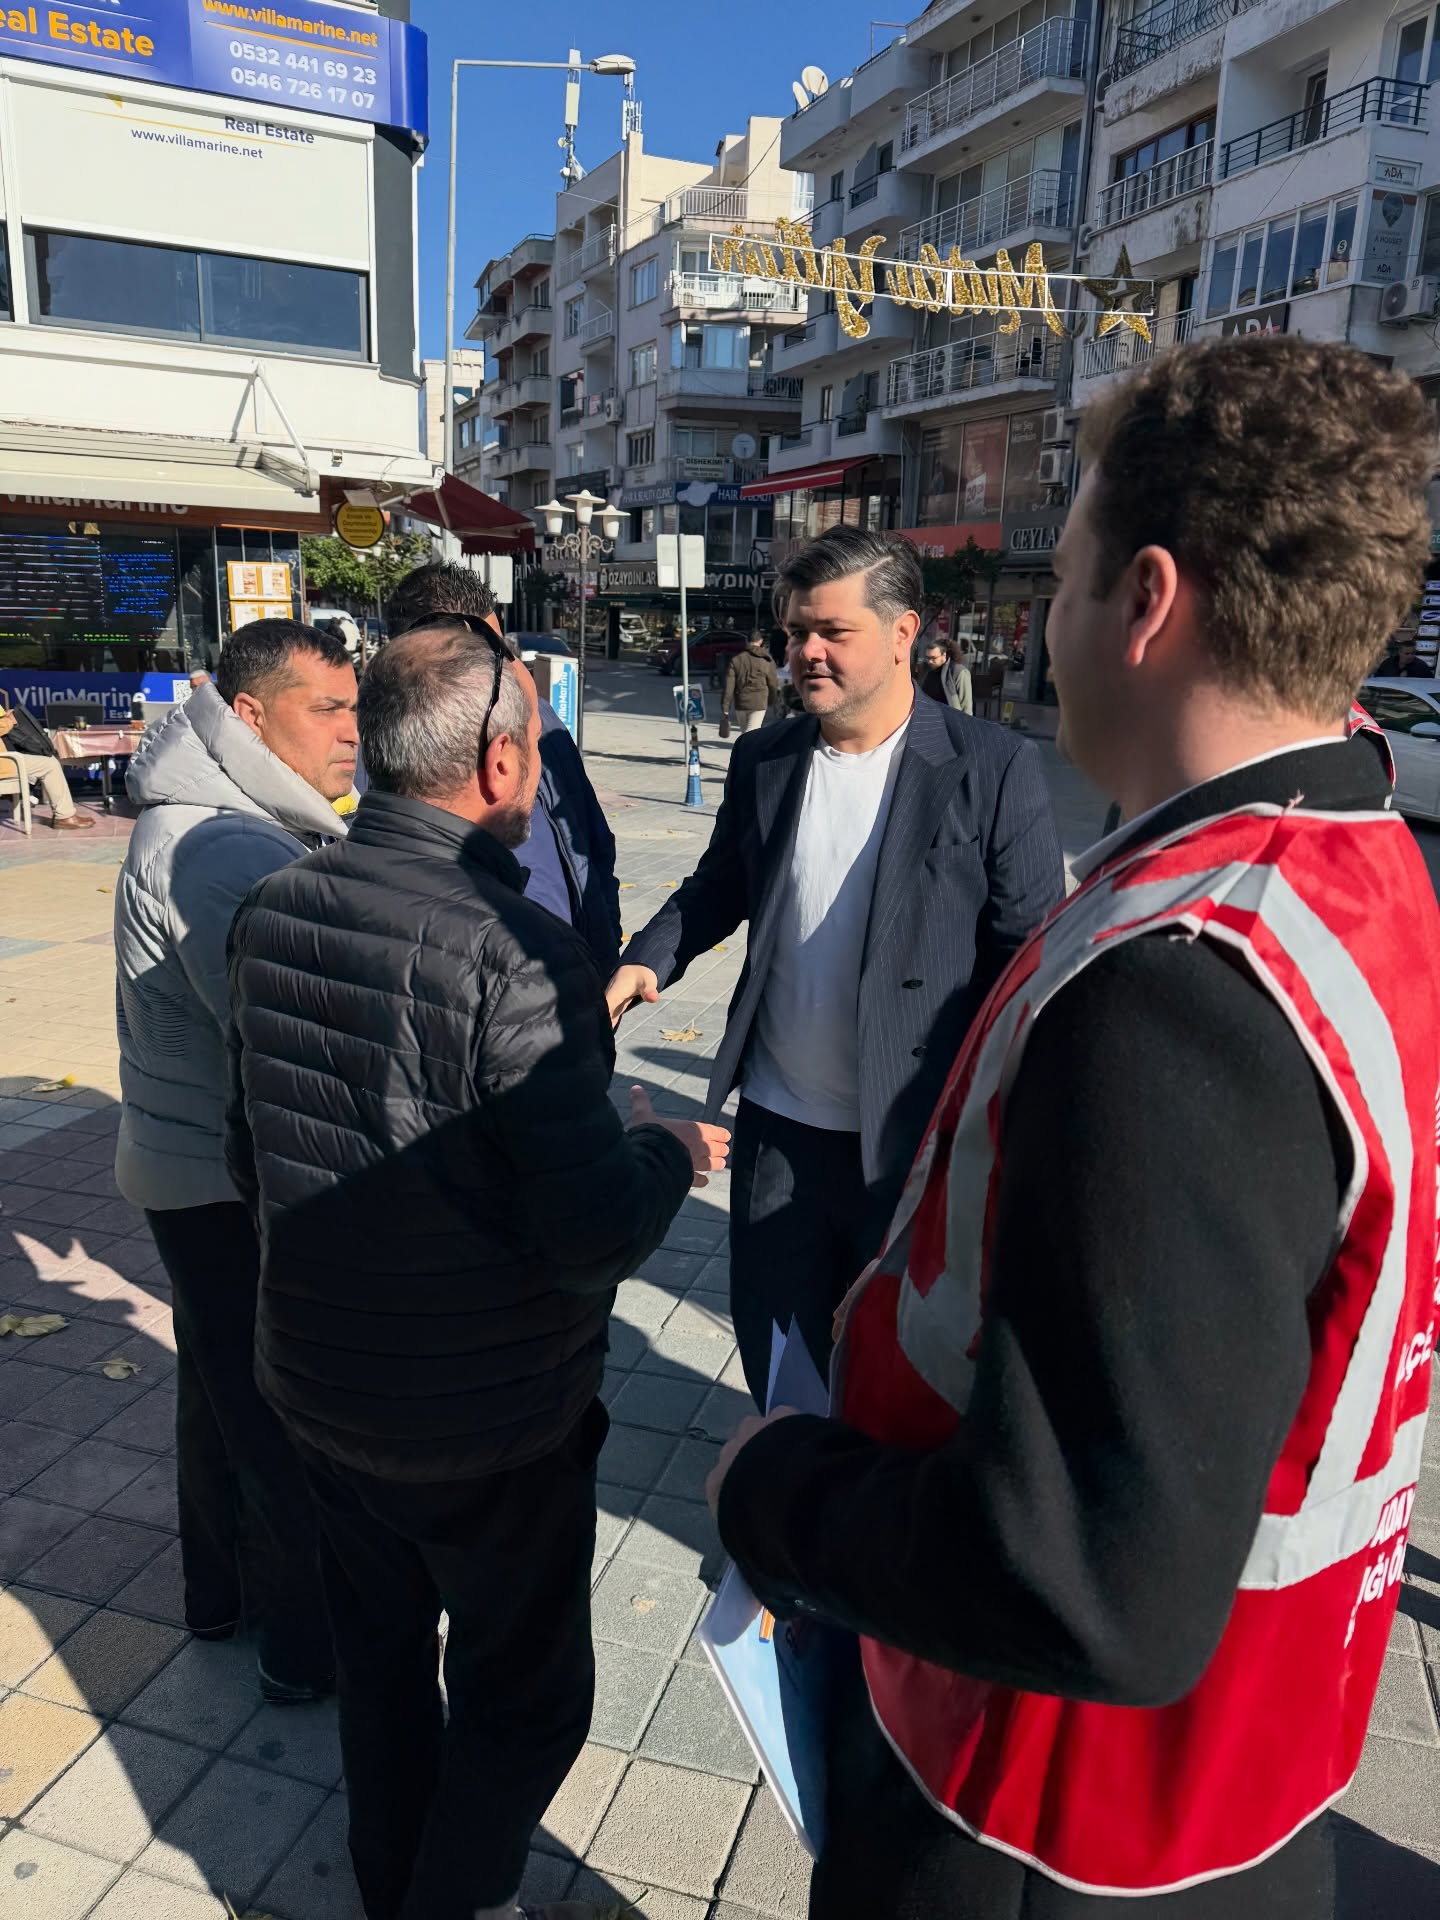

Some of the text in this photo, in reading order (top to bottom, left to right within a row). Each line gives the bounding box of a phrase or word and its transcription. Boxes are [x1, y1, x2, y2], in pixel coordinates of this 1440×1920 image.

[48, 11, 154, 56] Estate
[203, 0, 378, 47] www.villamarine.net
[229, 40, 377, 85] 0532 441 69 23
[231, 66, 375, 109] 0546 726 17 07
[131, 128, 263, 159] www.villamarine.net
[224, 115, 315, 144] Real Estate
[1010, 528, 1062, 550] CEYLA
[14, 686, 146, 708] VillaMarine
